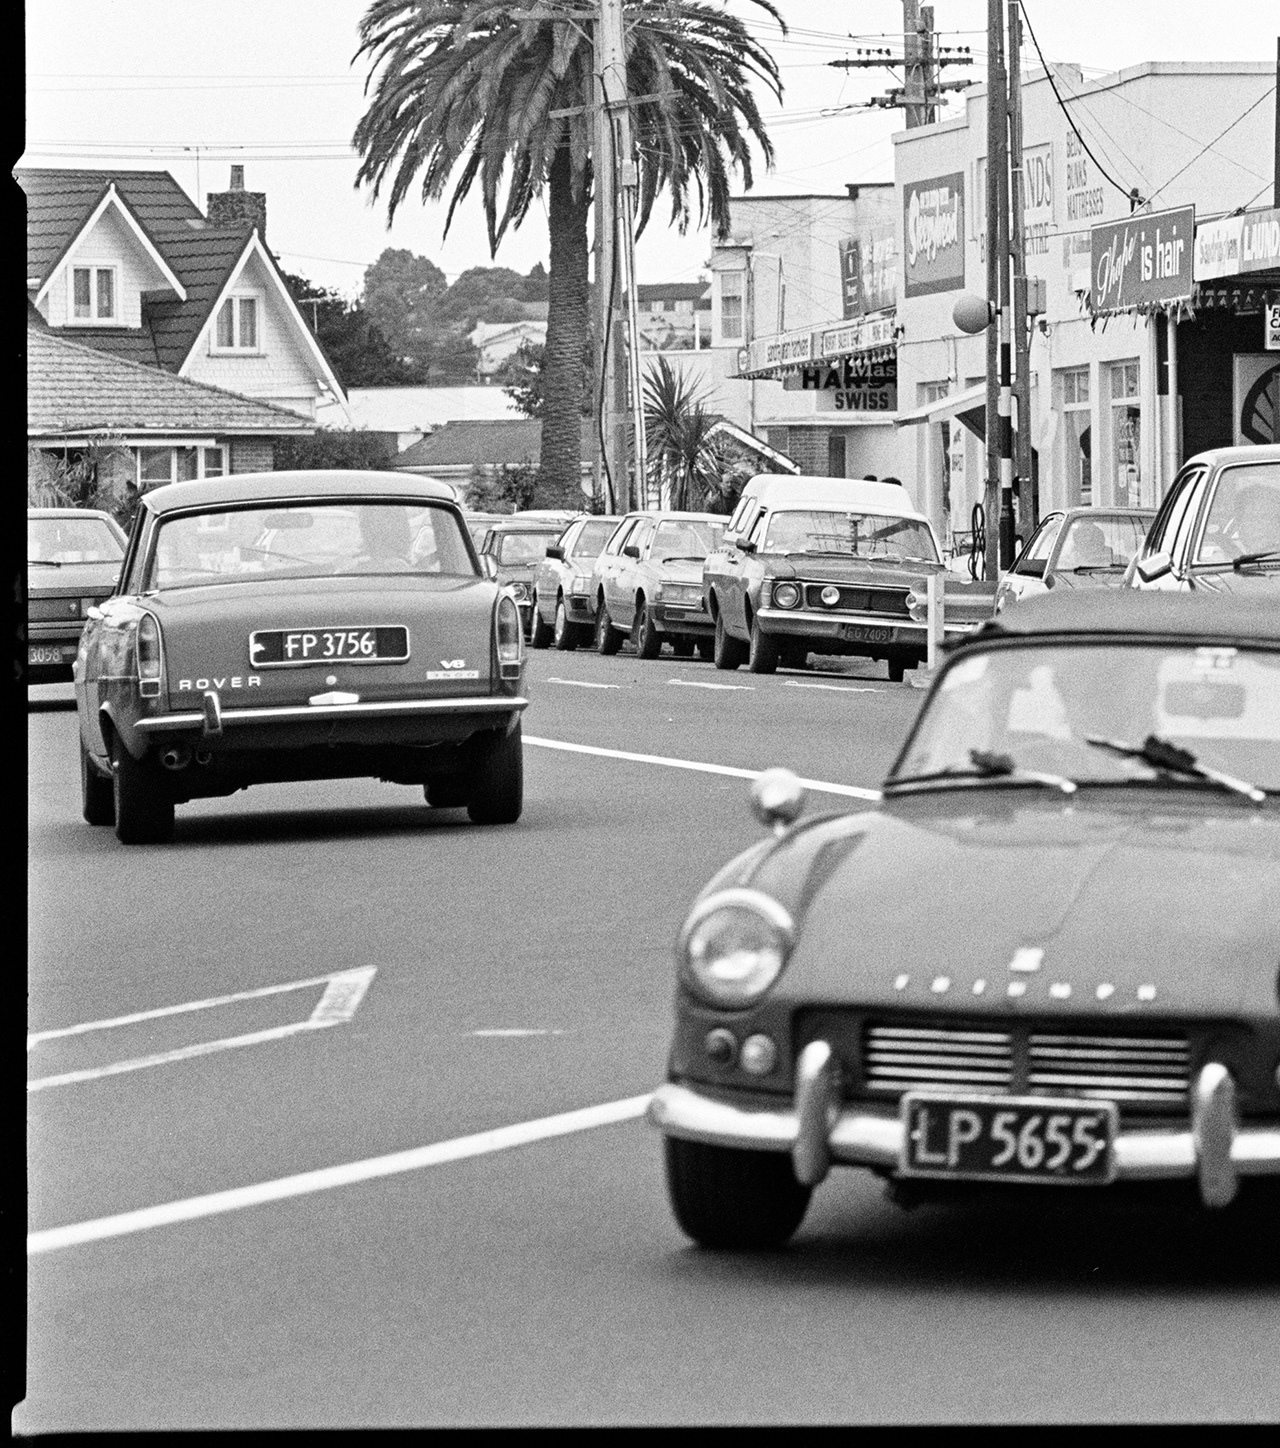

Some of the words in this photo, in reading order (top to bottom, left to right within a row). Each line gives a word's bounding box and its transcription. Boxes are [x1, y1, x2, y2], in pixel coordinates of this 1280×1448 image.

[1141, 231, 1153, 281] is
[1156, 225, 1184, 279] hair
[834, 390, 889, 410] SWISS
[286, 635, 318, 657] FP
[322, 633, 373, 656] 3756
[440, 659, 466, 669] V8
[179, 675, 262, 691] ROVER
[913, 1109, 983, 1167] LP
[990, 1110, 1106, 1171] 5655
